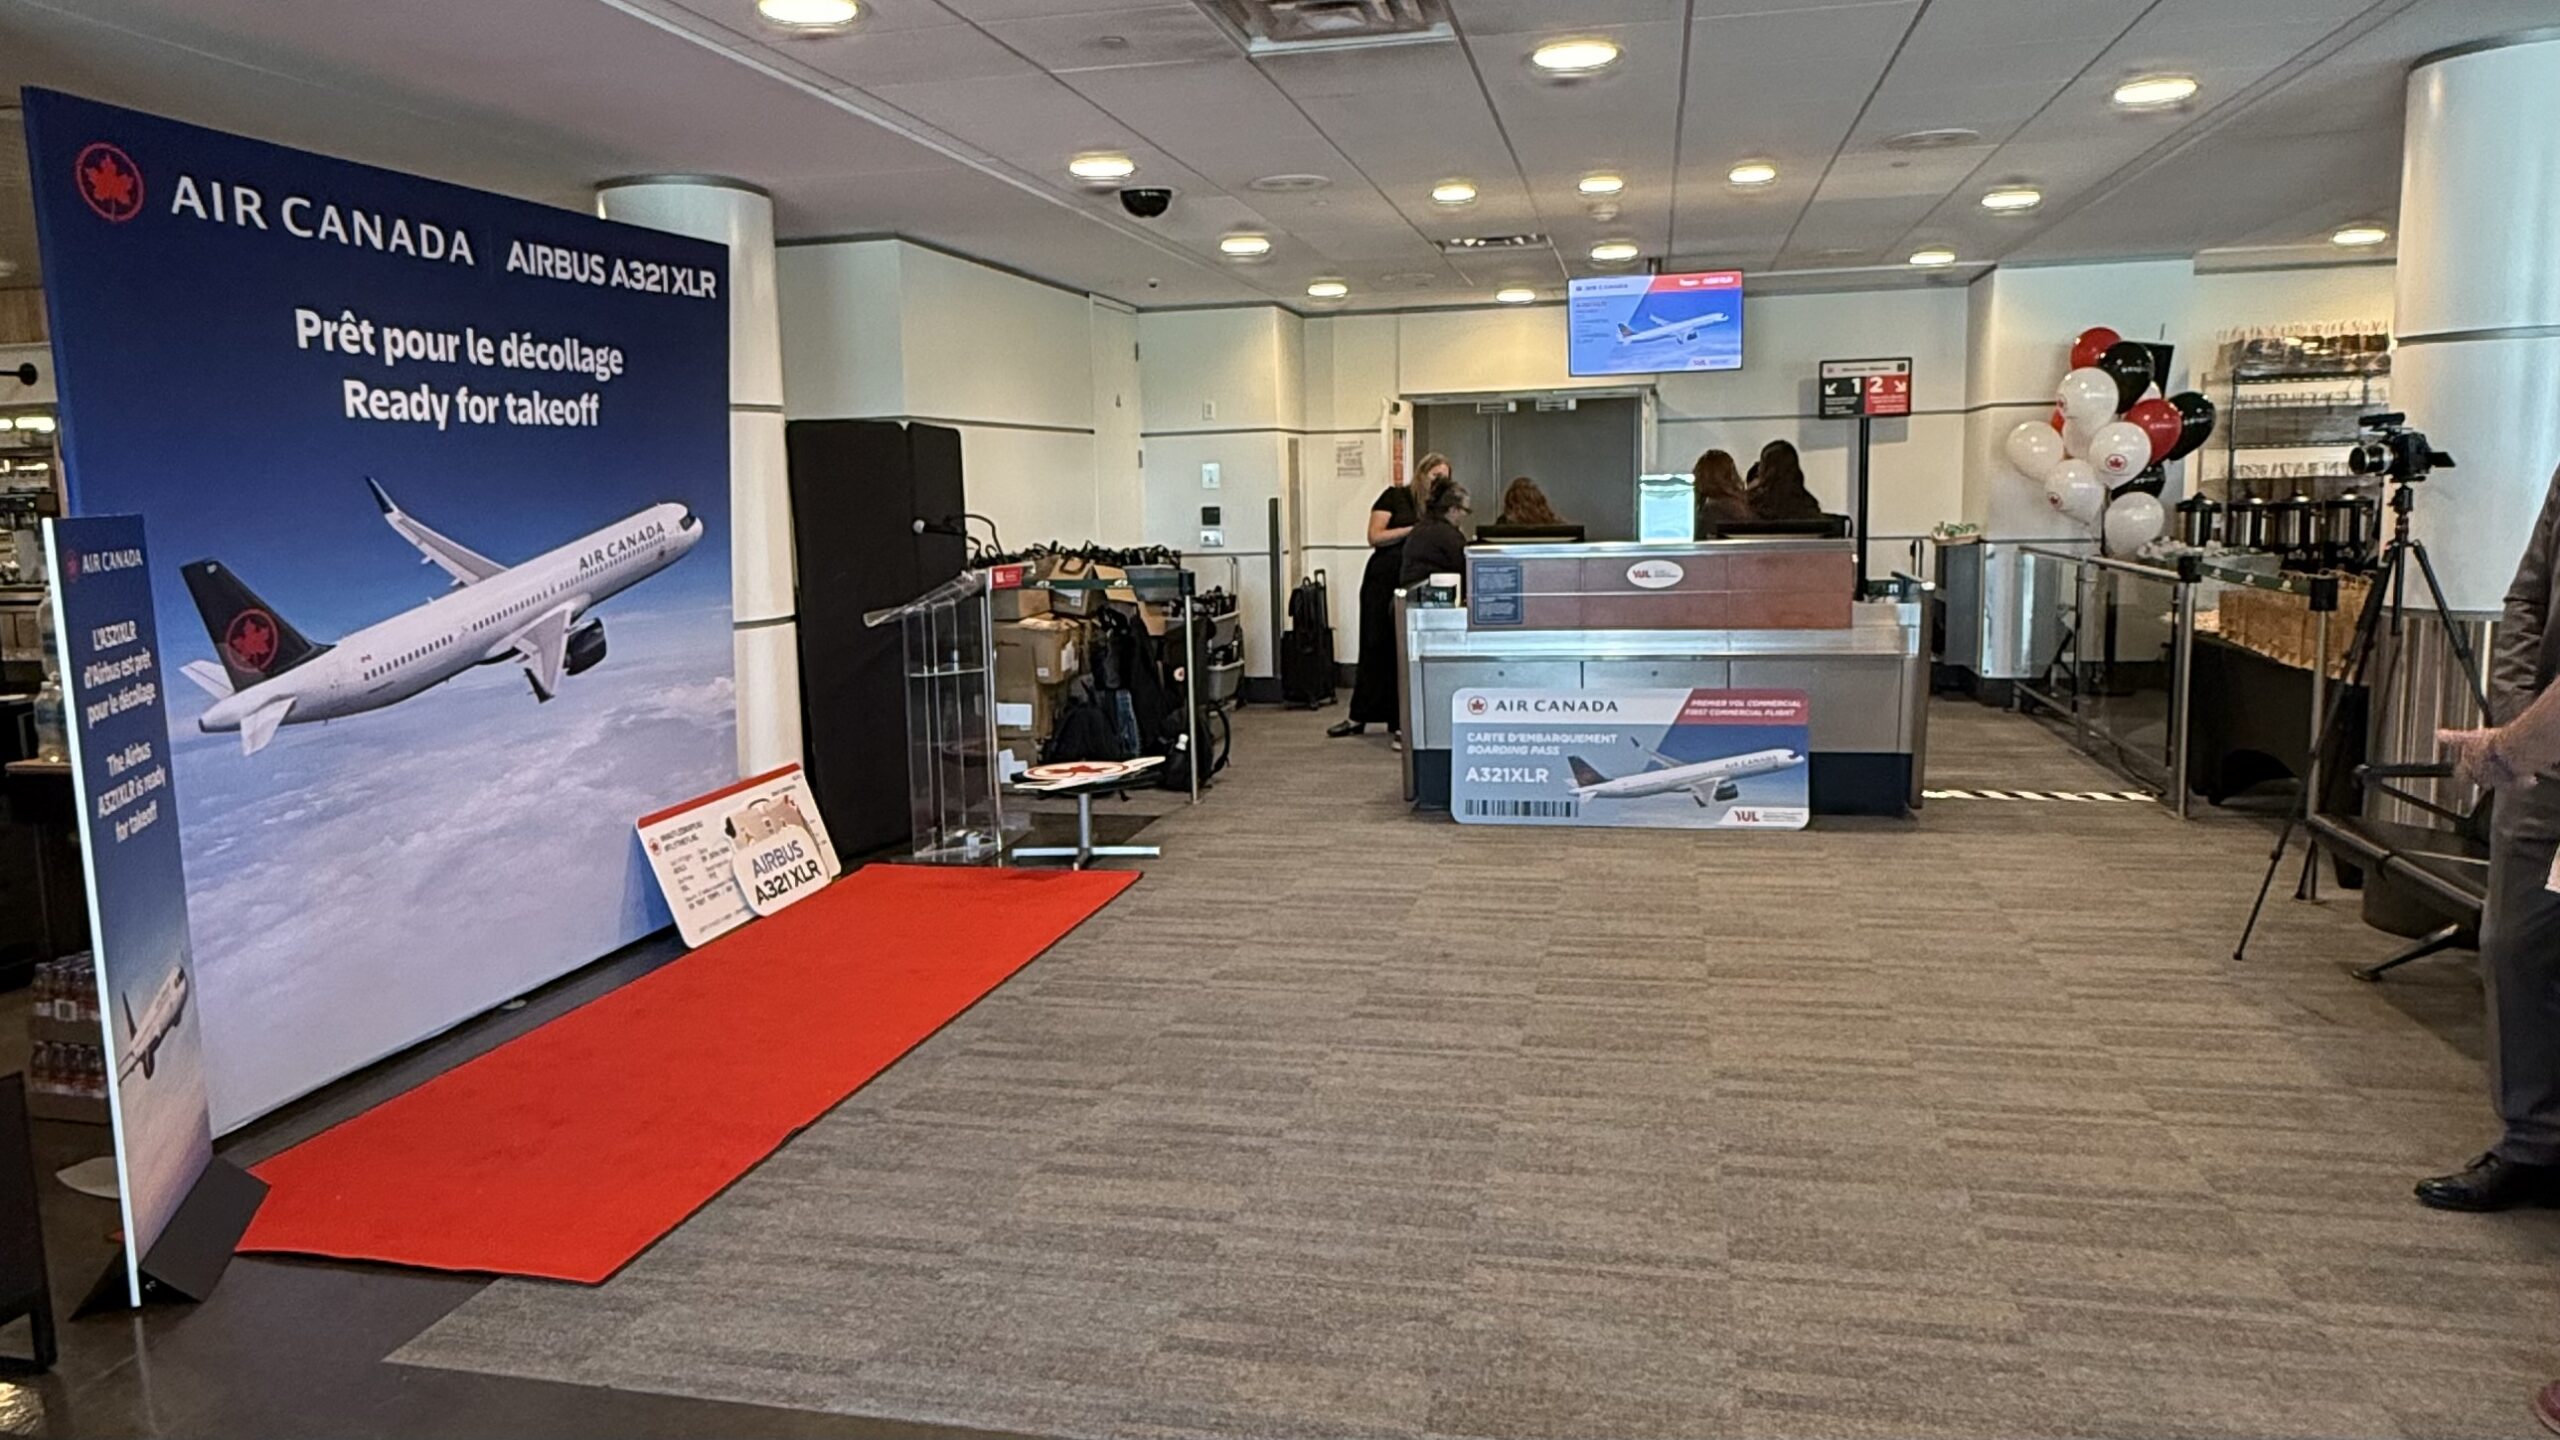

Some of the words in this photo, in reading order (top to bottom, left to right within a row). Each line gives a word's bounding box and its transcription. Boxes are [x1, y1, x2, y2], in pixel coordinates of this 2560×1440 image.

[171, 175, 268, 230] AIR
[281, 196, 475, 266] CANADA
[506, 240, 606, 285] AIRBUS
[610, 258, 716, 299] A321XLR
[295, 308, 376, 355] Prêt
[382, 326, 460, 366] pour
[466, 327, 495, 366] le
[500, 331, 624, 382] décollage
[1851, 377, 1860, 395] 1
[1869, 376, 1884, 393] 2
[343, 379, 449, 431] Ready
[456, 386, 500, 424] for
[505, 390, 599, 427] takeoff
[579, 549, 605, 571] AIR
[606, 521, 665, 558] CANADA
[82, 553, 101, 573] AIR
[102, 549, 143, 571] CANADA
[87, 701, 109, 729] pour
[109, 693, 119, 714] le
[1495, 700, 1528, 712] AIR
[1534, 700, 1618, 713] CANADA
[1467, 732, 1505, 743] CARTE
[1507, 732, 1618, 744] D'EMBARQUEMENT
[1467, 745, 1528, 755] BOARDING
[1530, 746, 1560, 755] PASS
[106, 753, 125, 777] The
[125, 742, 151, 768] Airbus
[135, 775, 144, 796] is
[144, 764, 166, 792] ready
[1465, 766, 1549, 783] A321XLR
[1734, 811, 1760, 822] YUL
[115, 821, 128, 843] for
[752, 839, 804, 879] AIRBUS
[755, 859, 822, 906] A321XLR
